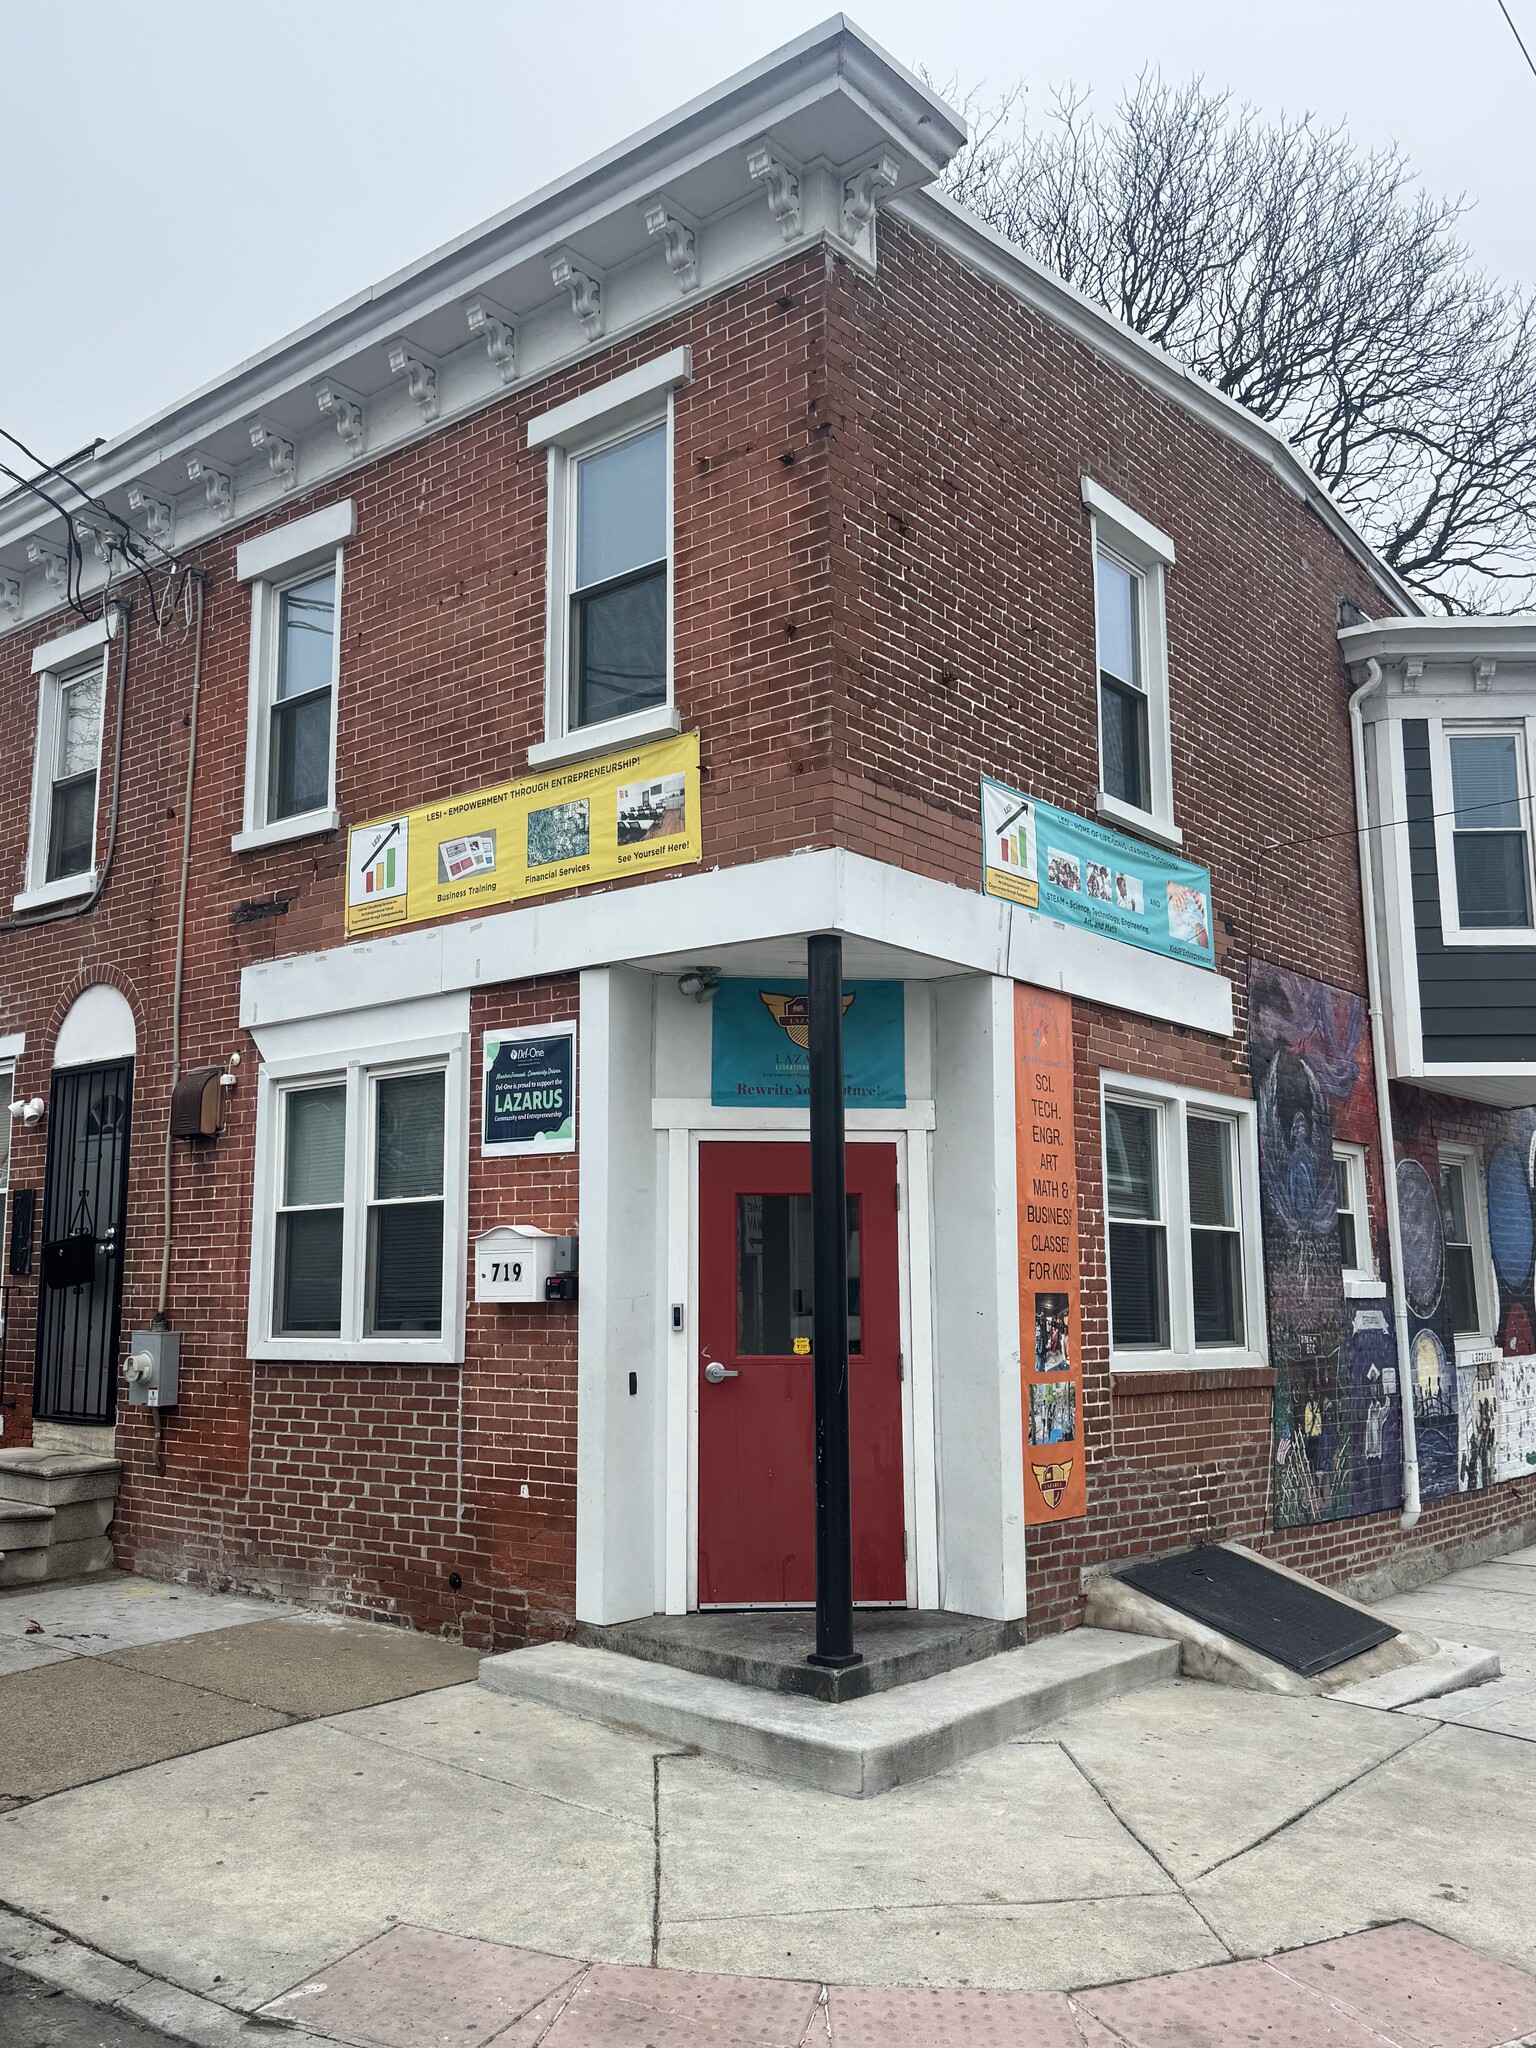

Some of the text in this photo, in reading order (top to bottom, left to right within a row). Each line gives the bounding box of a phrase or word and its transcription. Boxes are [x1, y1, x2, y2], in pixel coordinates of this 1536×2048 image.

[426, 811, 443, 822] LESI
[448, 792, 509, 816] EMPOWERMENT
[510, 781, 549, 799] THROUGH
[551, 756, 641, 788] ENTREPRENEURSHIP!
[617, 840, 690, 864] See Yourself Here!
[525, 863, 591, 884] Financial Services
[437, 882, 497, 902] Business Training
[1046, 892, 1065, 906] STEAM
[1069, 900, 1092, 915] Science,
[1092, 907, 1121, 925] Technology,
[1121, 917, 1150, 935] Engineering,
[1094, 920, 1105, 930] and
[1105, 923, 1118, 934] Math
[517, 1047, 545, 1060] Del-One
[776, 1053, 810, 1064] LAZA
[517, 1081, 531, 1090] proud
[536, 1080, 555, 1089] support
[737, 1083, 881, 1097] Rewrite Yo uture!
[1035, 1073, 1055, 1093] SCI.
[494, 1088, 563, 1113] LAZARUS
[1031, 1098, 1062, 1120] TECH.
[494, 1114, 518, 1123] Community
[526, 1110, 563, 1121] Entrepreneurship
[1032, 1125, 1064, 1146] ENGR.
[1040, 1153, 1058, 1172] ART
[1032, 1178, 1069, 1199] MATH &
[492, 1263, 522, 1282] 719
[1028, 1262, 1051, 1280] FOR
